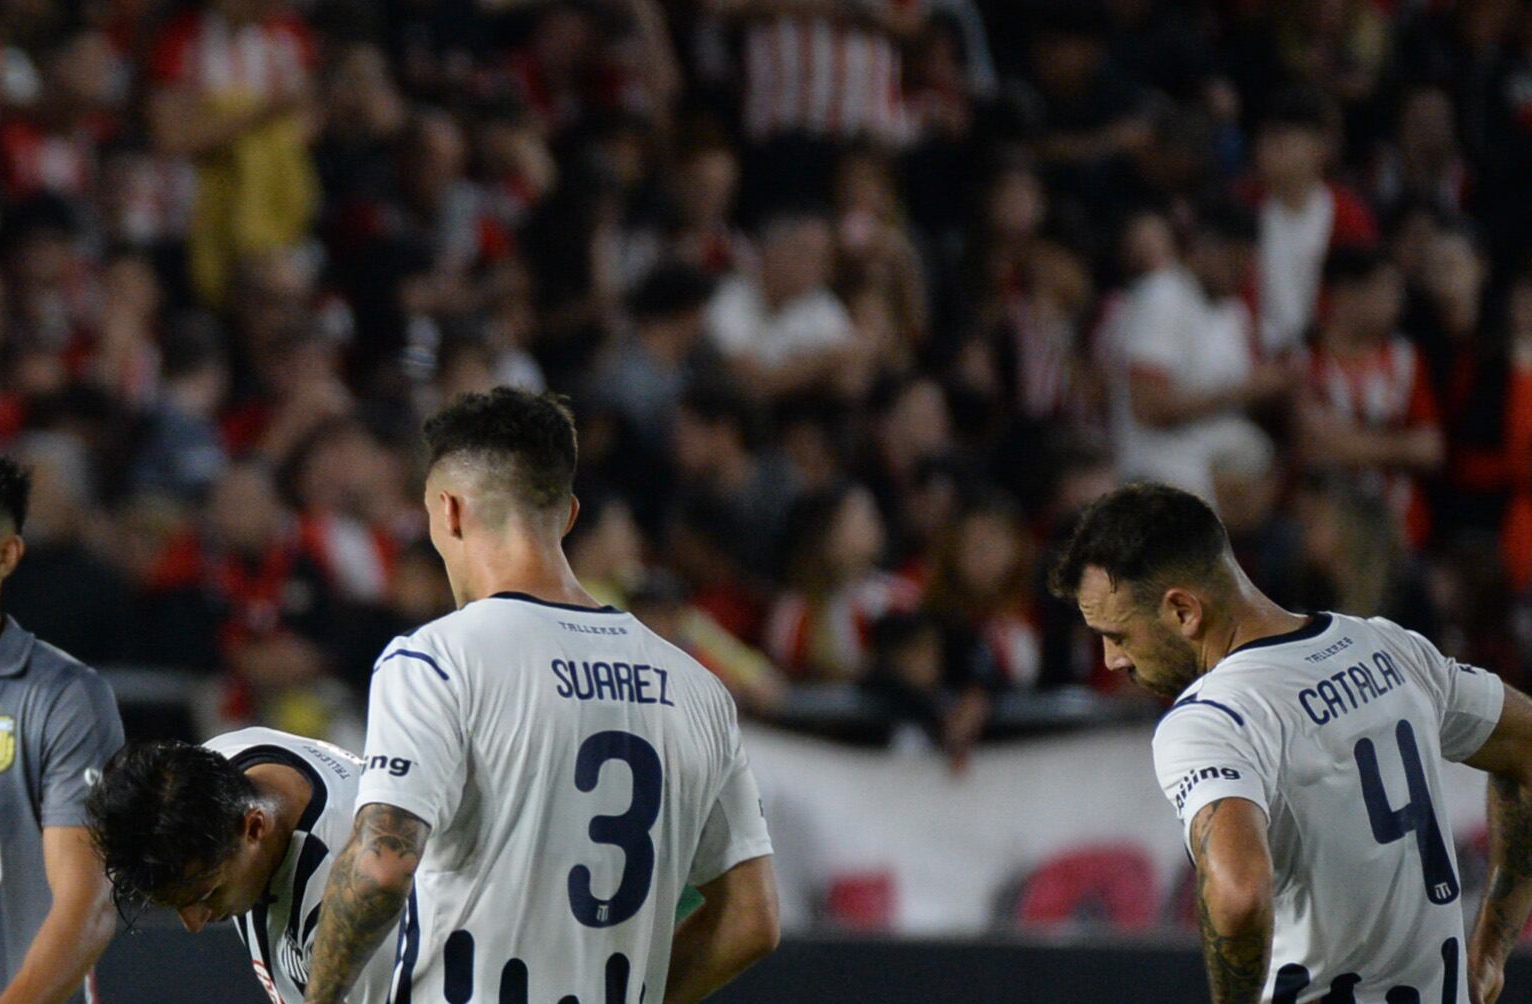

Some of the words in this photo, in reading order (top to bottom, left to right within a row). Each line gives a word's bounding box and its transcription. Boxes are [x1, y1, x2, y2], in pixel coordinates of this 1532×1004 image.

[550, 658, 676, 707] SUAREZ
[568, 729, 663, 929] 3
[1354, 718, 1460, 905] 4
